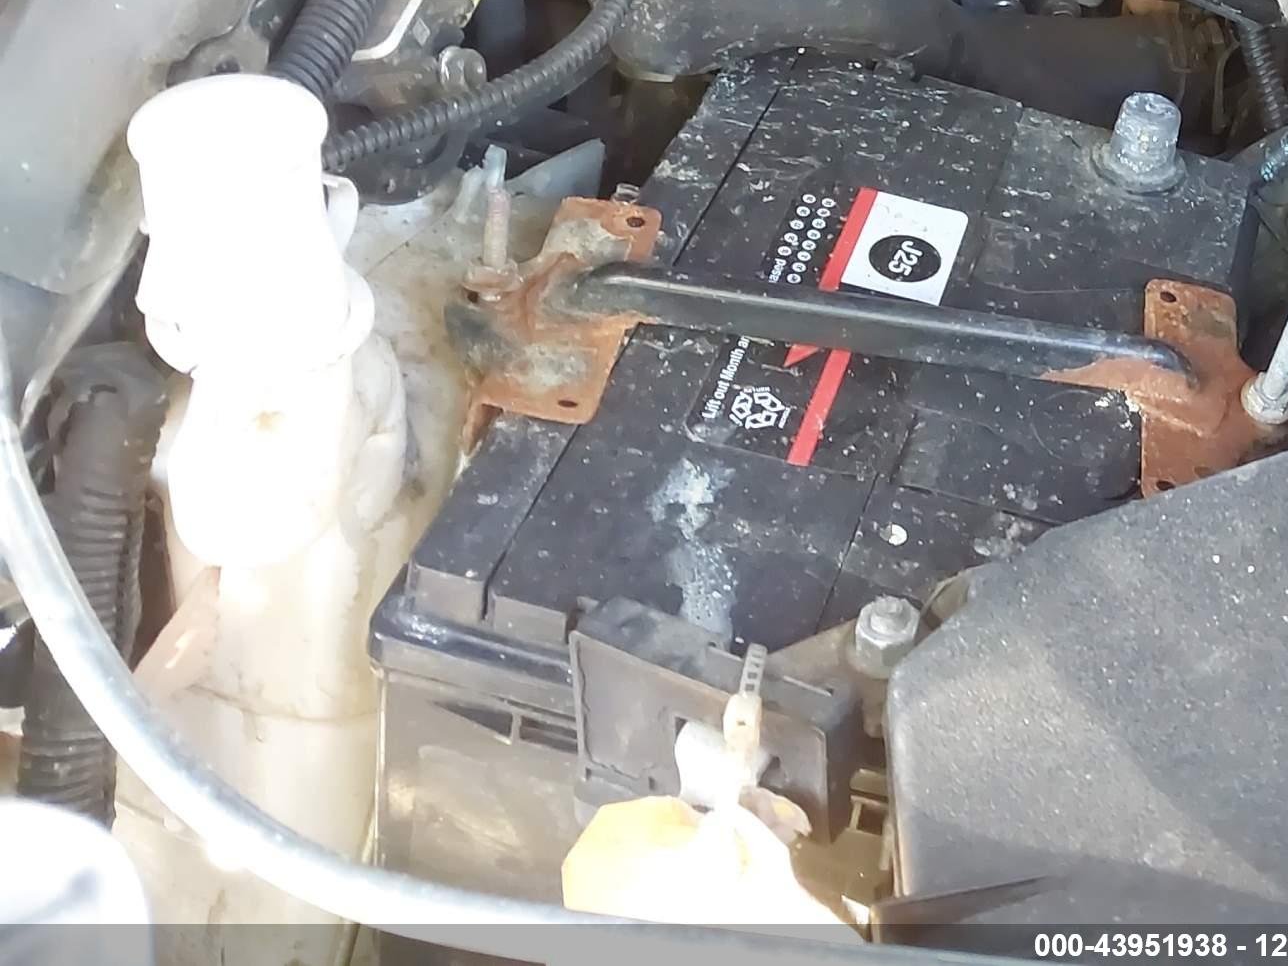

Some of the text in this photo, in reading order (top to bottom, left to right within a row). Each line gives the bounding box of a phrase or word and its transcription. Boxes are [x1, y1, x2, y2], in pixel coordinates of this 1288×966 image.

[888, 240, 923, 276] J25
[719, 348, 746, 382] Month
[714, 380, 731, 400] out
[701, 399, 722, 419] Lift
